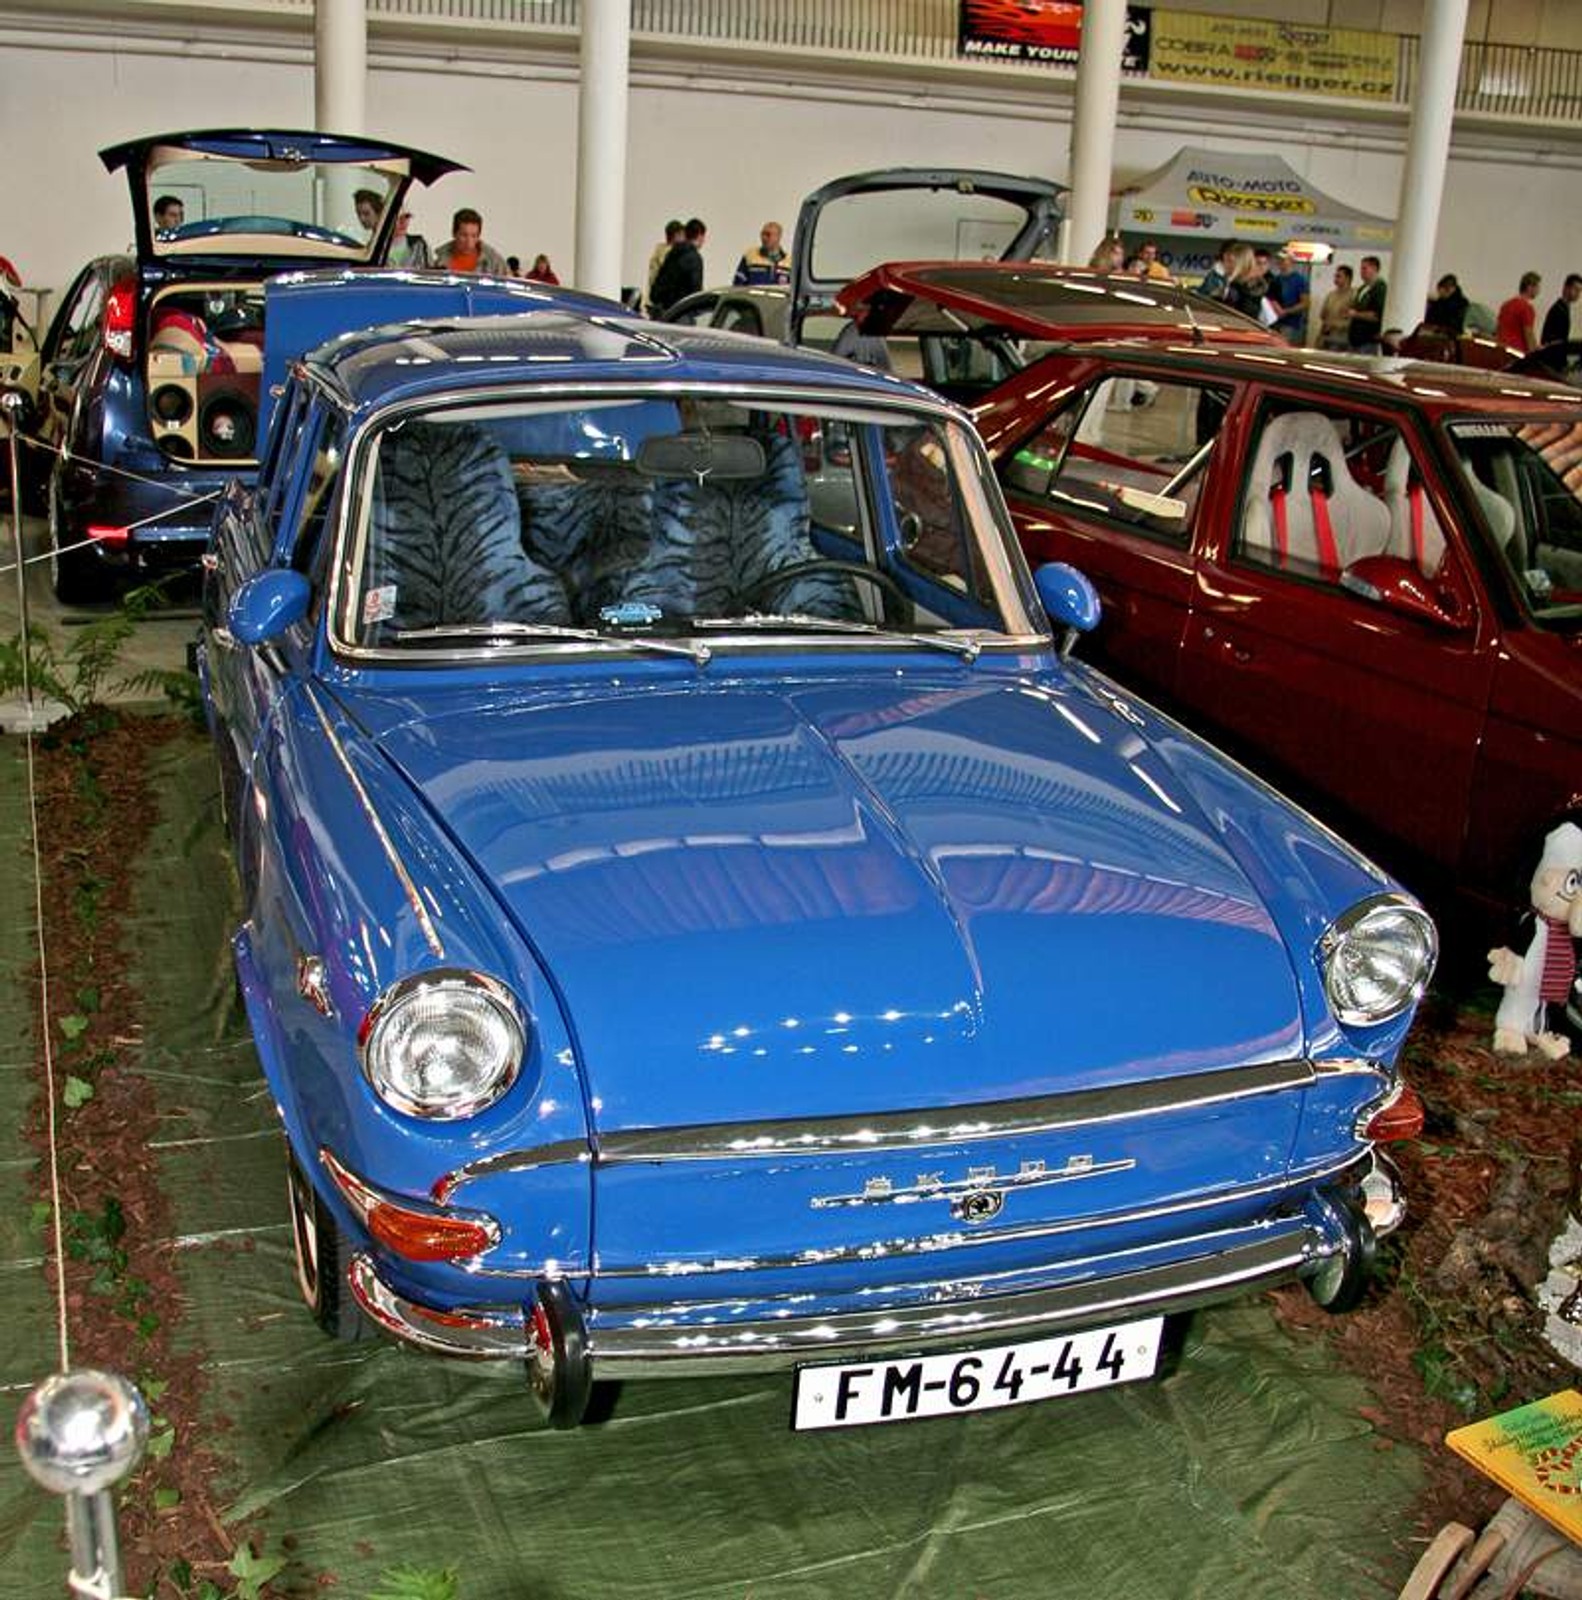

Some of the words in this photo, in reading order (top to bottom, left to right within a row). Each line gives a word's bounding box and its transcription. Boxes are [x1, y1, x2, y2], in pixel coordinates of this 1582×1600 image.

[965, 40, 1021, 56] MAKE
[1026, 46, 1078, 61] YOUR
[1155, 36, 1232, 56] COBRA
[1156, 62, 1394, 94] www.riegger.cz
[834, 1332, 1126, 1420] FM-64-44
